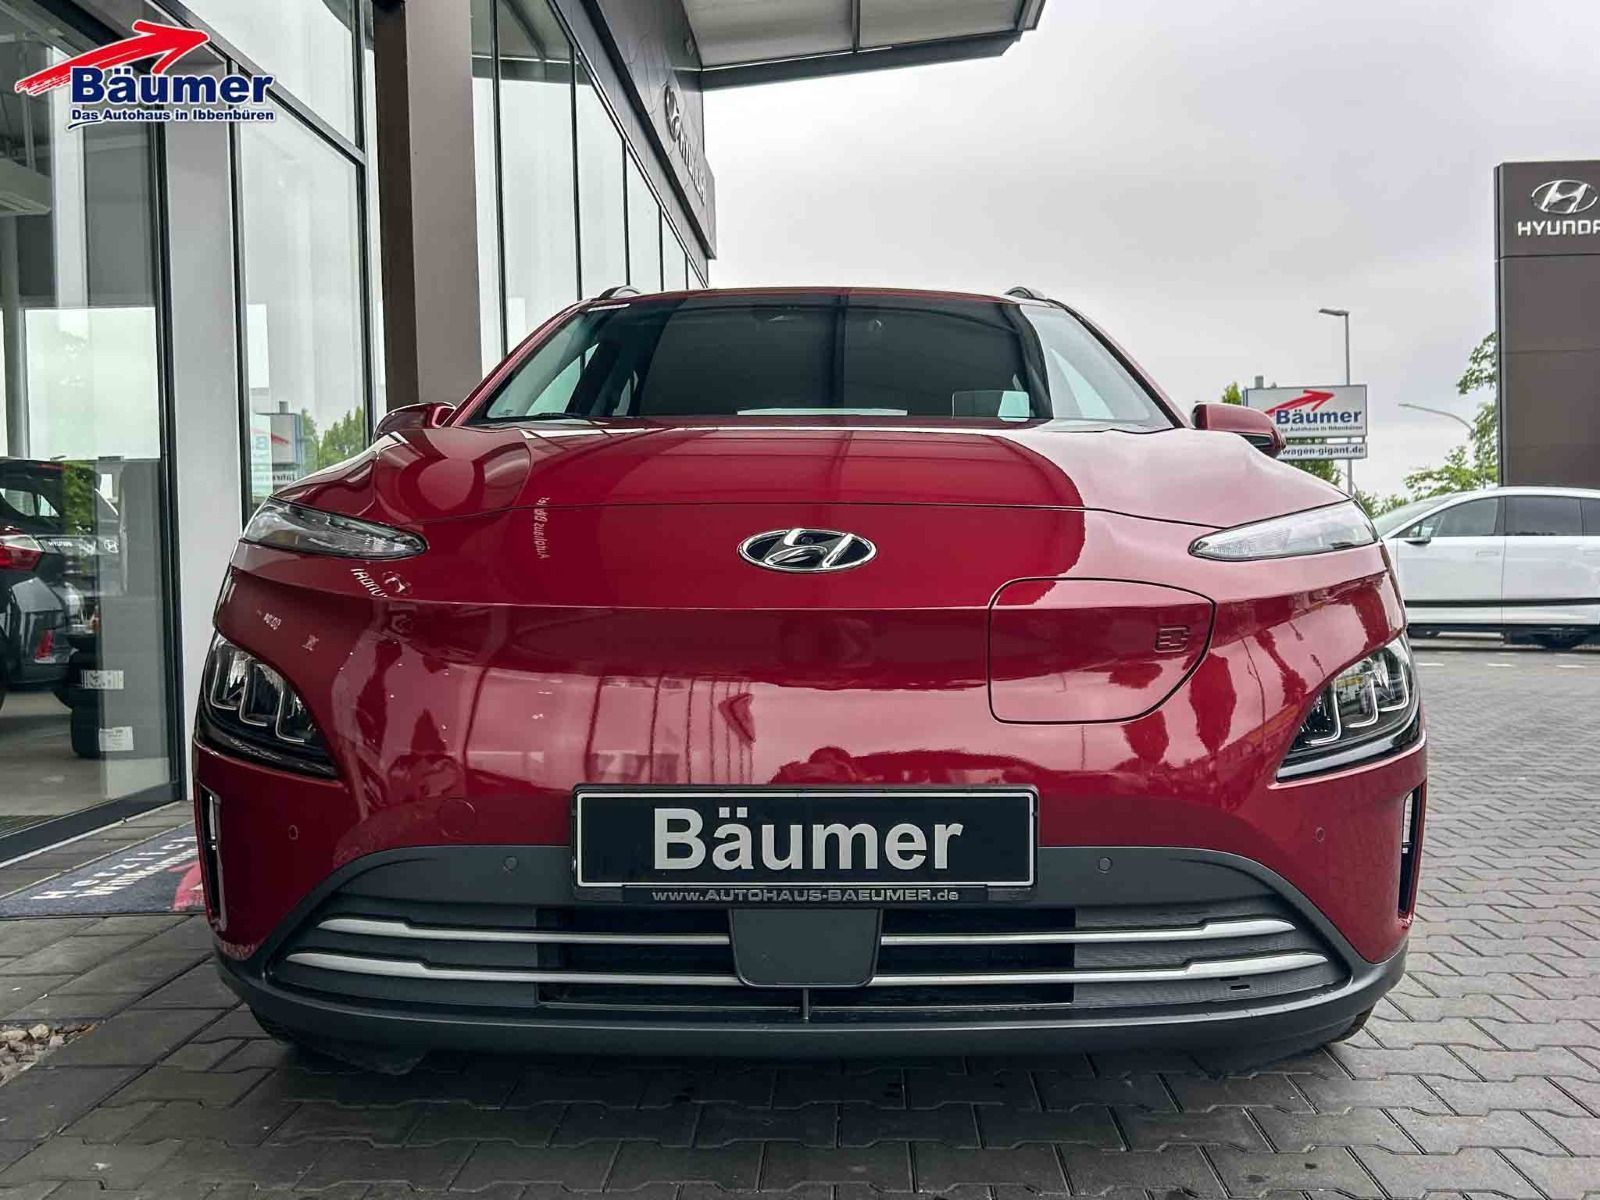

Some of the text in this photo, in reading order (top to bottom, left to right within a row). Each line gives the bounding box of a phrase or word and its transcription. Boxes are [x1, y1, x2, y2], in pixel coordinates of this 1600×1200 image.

[1275, 409, 1362, 424] Bäumer
[1281, 446, 1364, 457] wagen-gigant.de
[652, 806, 964, 871] Bäumer
[651, 889, 960, 901] www.AUTOHAUS-BAEUMER.de
